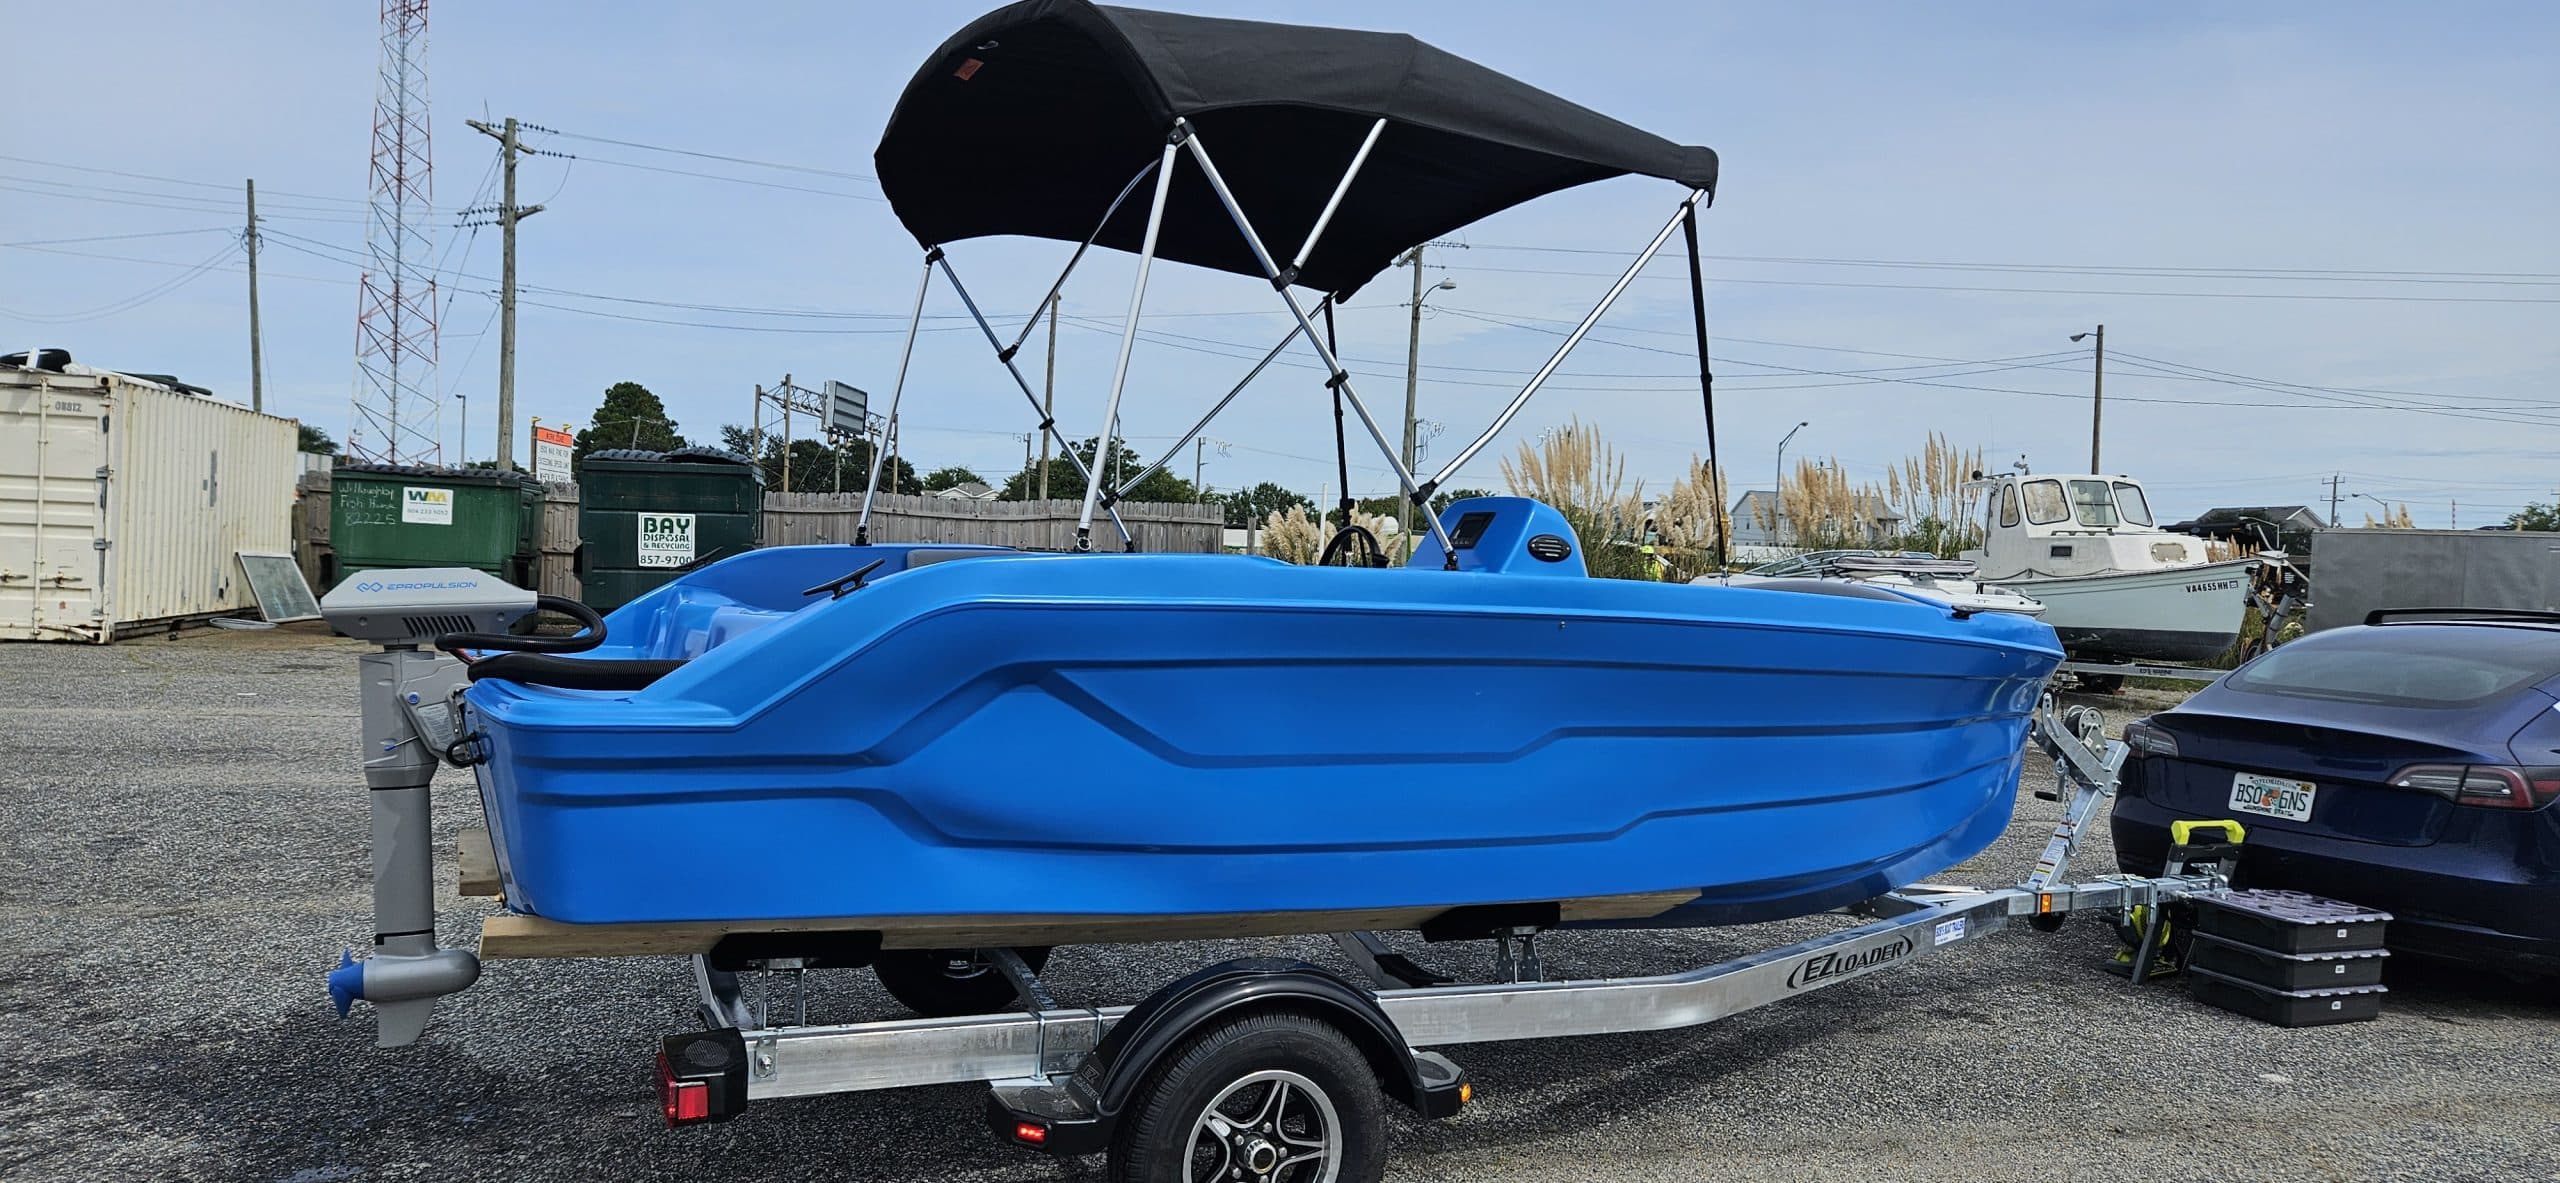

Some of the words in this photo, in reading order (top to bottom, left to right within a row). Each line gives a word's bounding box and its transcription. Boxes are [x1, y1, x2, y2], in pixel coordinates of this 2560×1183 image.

[408, 490, 447, 502] WM
[643, 517, 690, 534] BAY
[643, 533, 690, 542] DISPOSAL
[651, 542, 690, 550] RECYCLING
[640, 555, 692, 565] 857-9700
